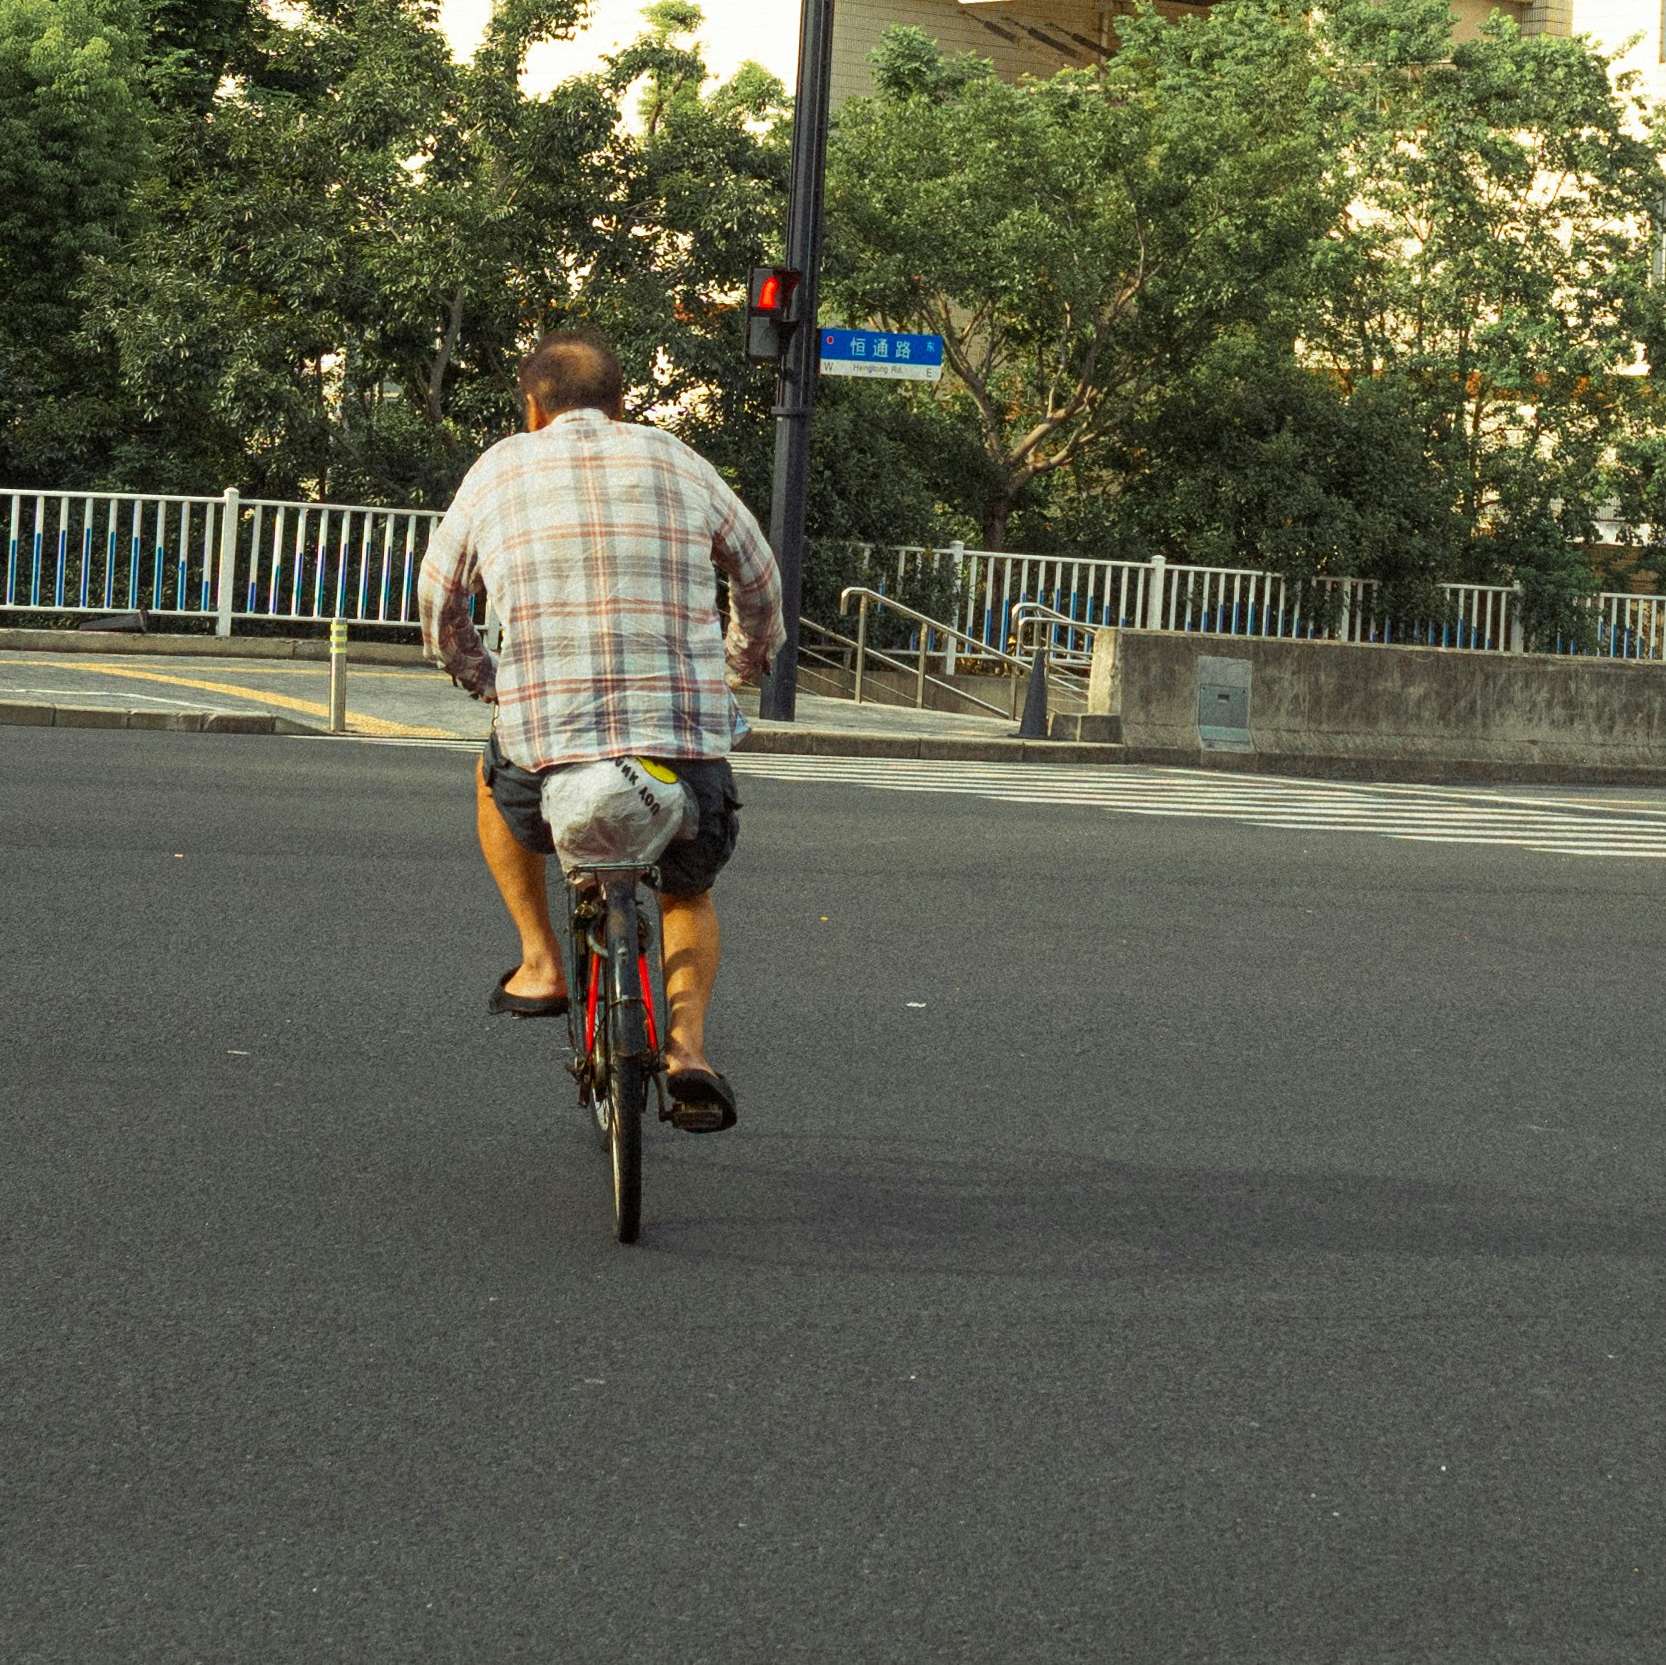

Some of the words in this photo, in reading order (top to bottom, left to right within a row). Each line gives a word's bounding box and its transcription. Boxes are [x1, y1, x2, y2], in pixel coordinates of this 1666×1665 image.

[850, 337, 911, 359] 恒通路
[926, 341, 935, 352] 东
[824, 362, 834, 372] W
[853, 364, 888, 375] Hengtong
[926, 368, 932, 377] E
